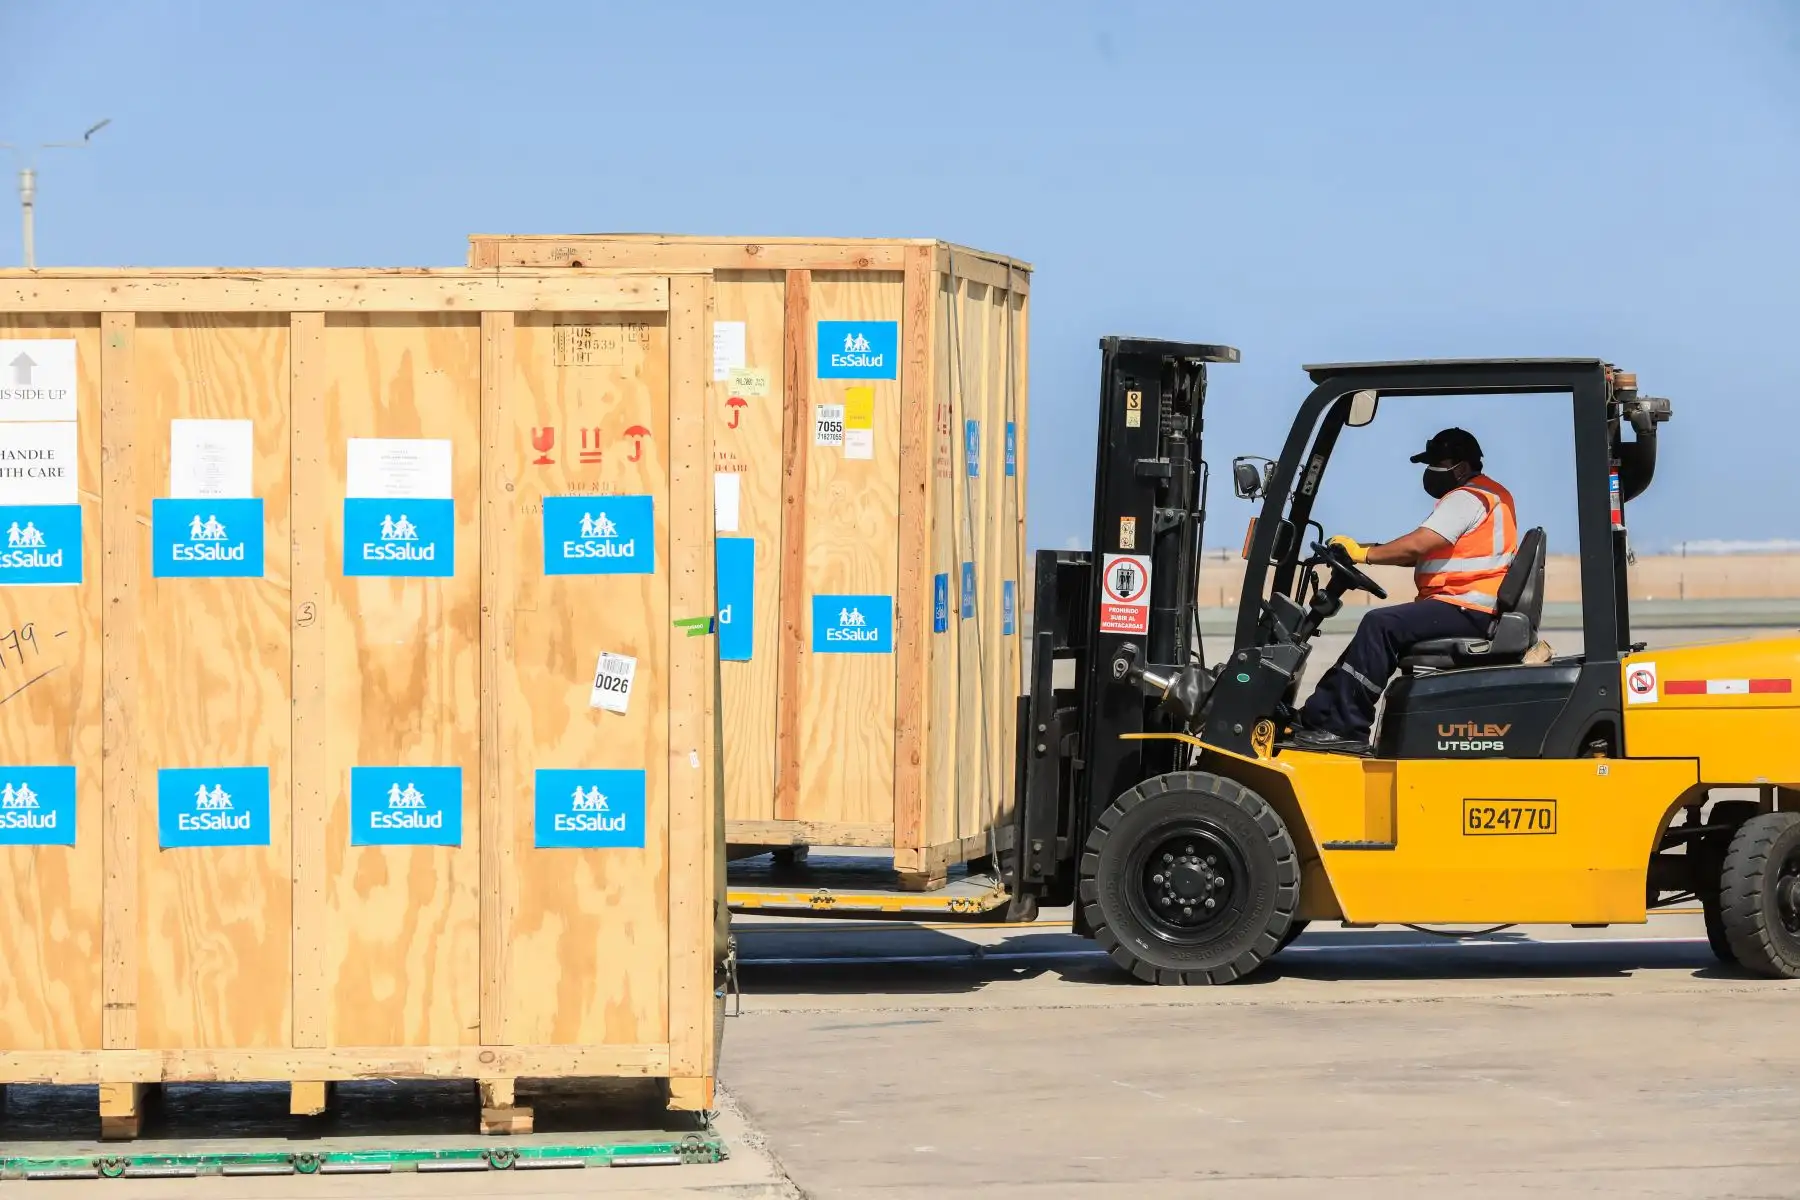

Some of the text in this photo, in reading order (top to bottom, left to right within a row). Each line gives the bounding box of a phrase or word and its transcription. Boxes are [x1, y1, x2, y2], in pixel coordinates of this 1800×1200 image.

[832, 354, 882, 367] EsSalud
[14, 389, 45, 400] SIDE
[48, 389, 67, 400] UP
[817, 421, 842, 432] 7055
[27, 467, 65, 478] CARE
[173, 543, 244, 561] EsSalud
[363, 543, 434, 560] EsSalud
[563, 540, 634, 558] EsSalud
[1102, 621, 1143, 629] MONTACARGAS
[827, 627, 878, 641] EsSalud
[595, 673, 629, 694] 0026
[1438, 722, 1512, 738] UTILEV
[1437, 741, 1504, 751] UT50PS
[178, 811, 250, 830] EsSalud
[371, 811, 442, 829] EsSalud
[554, 813, 626, 831] EsSalud
[1469, 808, 1551, 830] 624770
